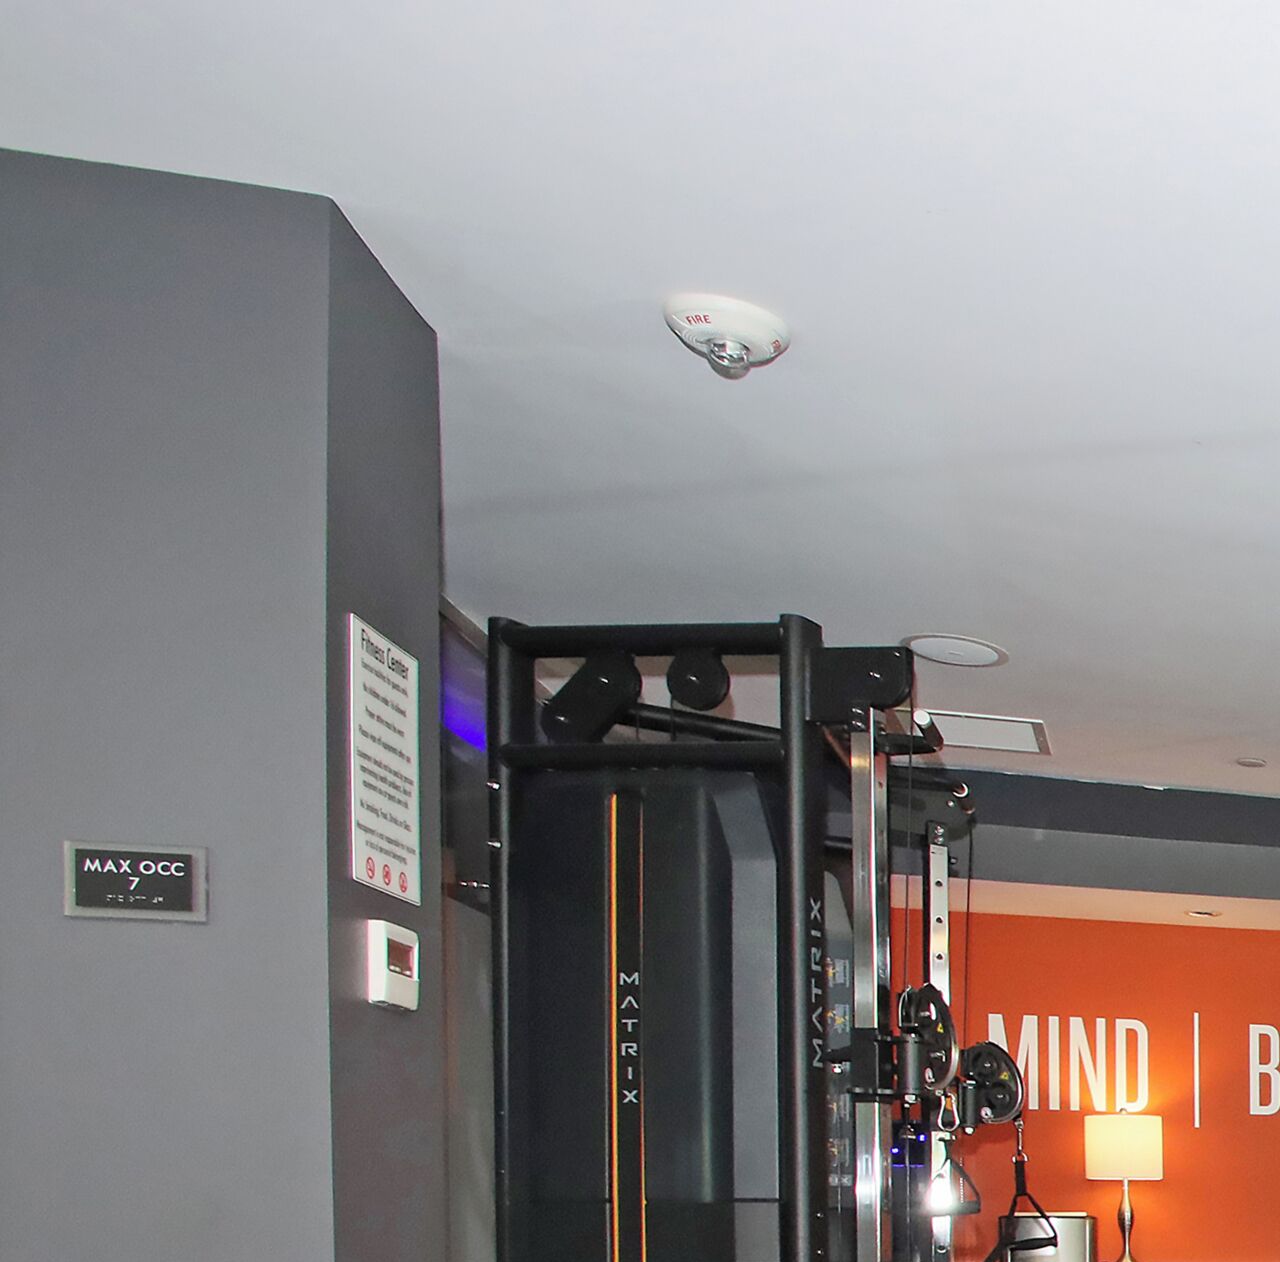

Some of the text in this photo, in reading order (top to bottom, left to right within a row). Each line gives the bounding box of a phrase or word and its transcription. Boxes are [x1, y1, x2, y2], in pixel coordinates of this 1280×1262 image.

[686, 314, 712, 326] FIRE
[83, 857, 185, 877] MAX OCC
[128, 876, 140, 891] 7
[810, 897, 824, 1068] MATRIX
[619, 971, 640, 1104] MATRIX
[988, 1012, 1149, 1113] MIND
